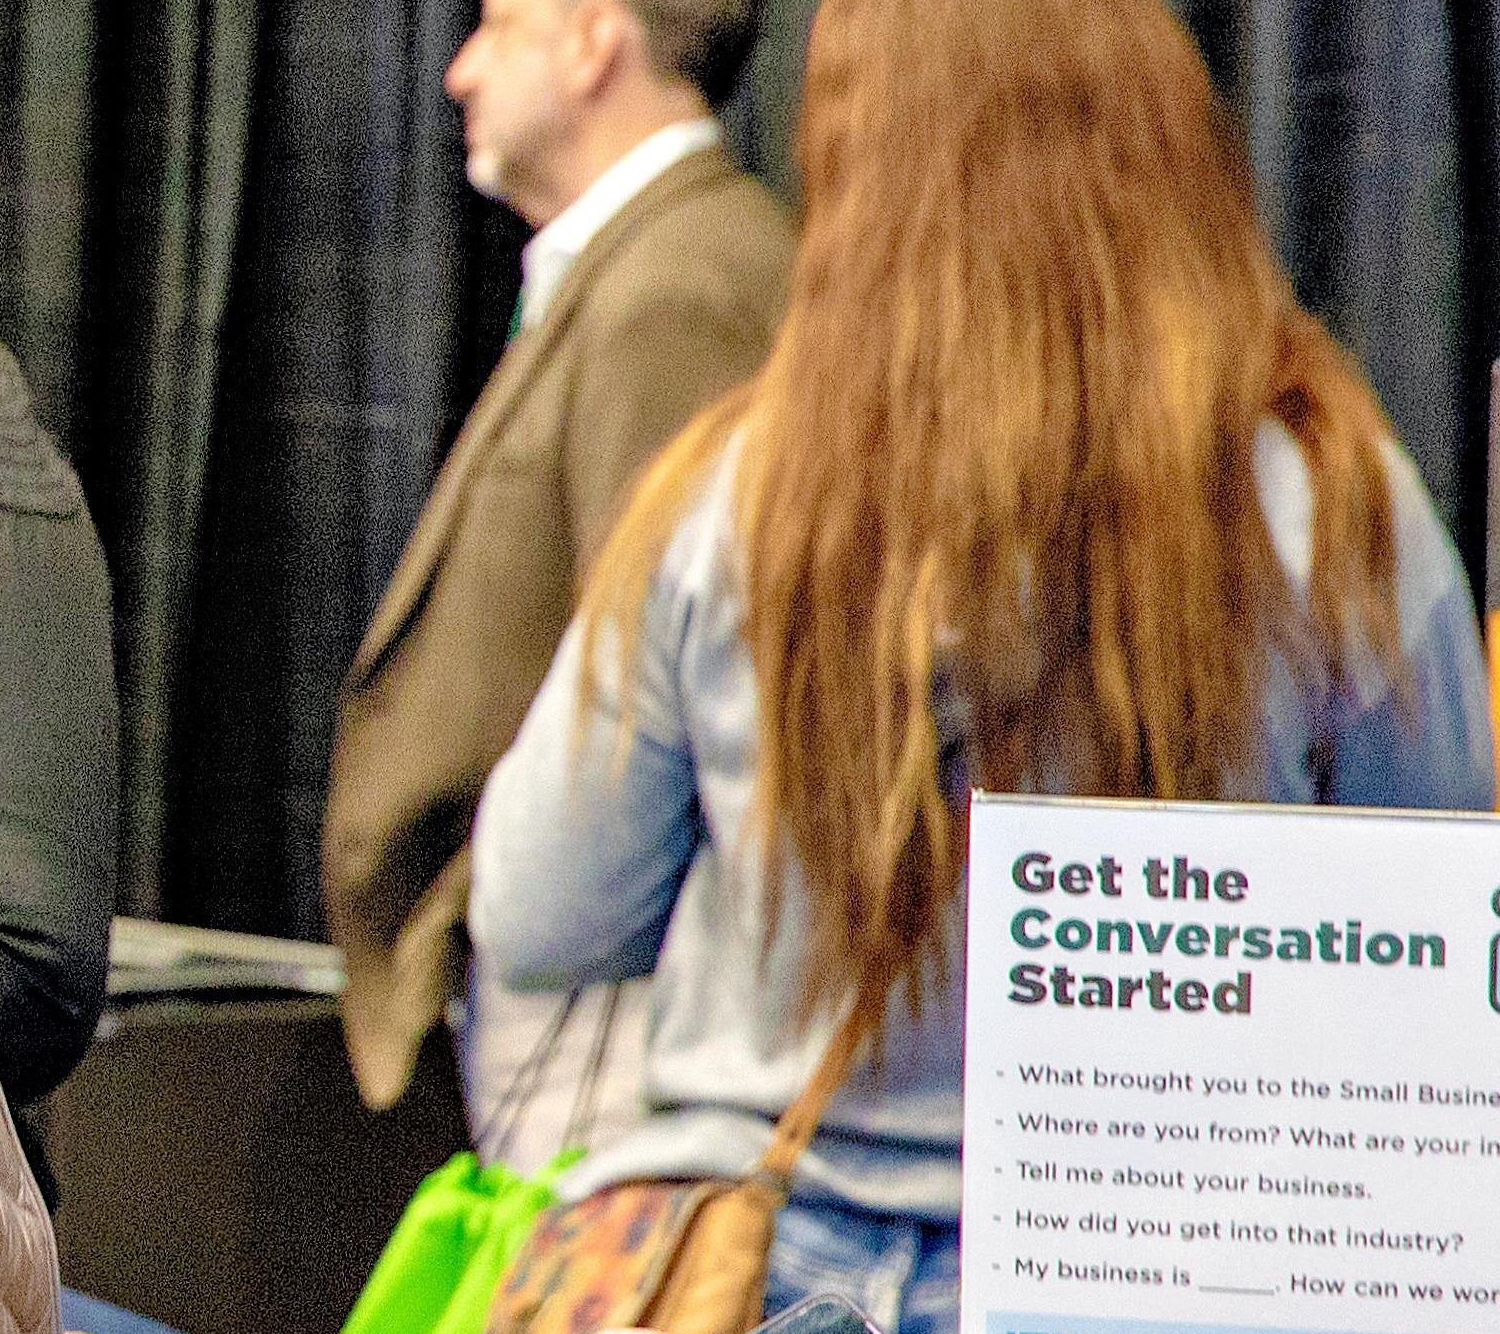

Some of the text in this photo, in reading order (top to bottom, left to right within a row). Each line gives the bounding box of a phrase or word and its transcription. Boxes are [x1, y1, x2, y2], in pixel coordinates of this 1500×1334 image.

[1011, 851, 1249, 901] Get the
[1009, 906, 1446, 968] Conversation
[1007, 963, 1252, 1015] Started
[1019, 1063, 1500, 1107] What brought you to the Small Busine
[1017, 1112, 1099, 1136] Where
[1107, 1120, 1145, 1138] are
[1155, 1123, 1200, 1142] you
[1209, 1122, 1280, 1145] from?
[1290, 1127, 1356, 1150] What
[1365, 1134, 1405, 1153] are
[1414, 1138, 1470, 1157] your
[1016, 1160, 1372, 1200] Tell me about your business.
[1015, 1209, 1464, 1255] How did you get into that industry?
[1014, 1257, 1500, 1305] My business is How can we wor
